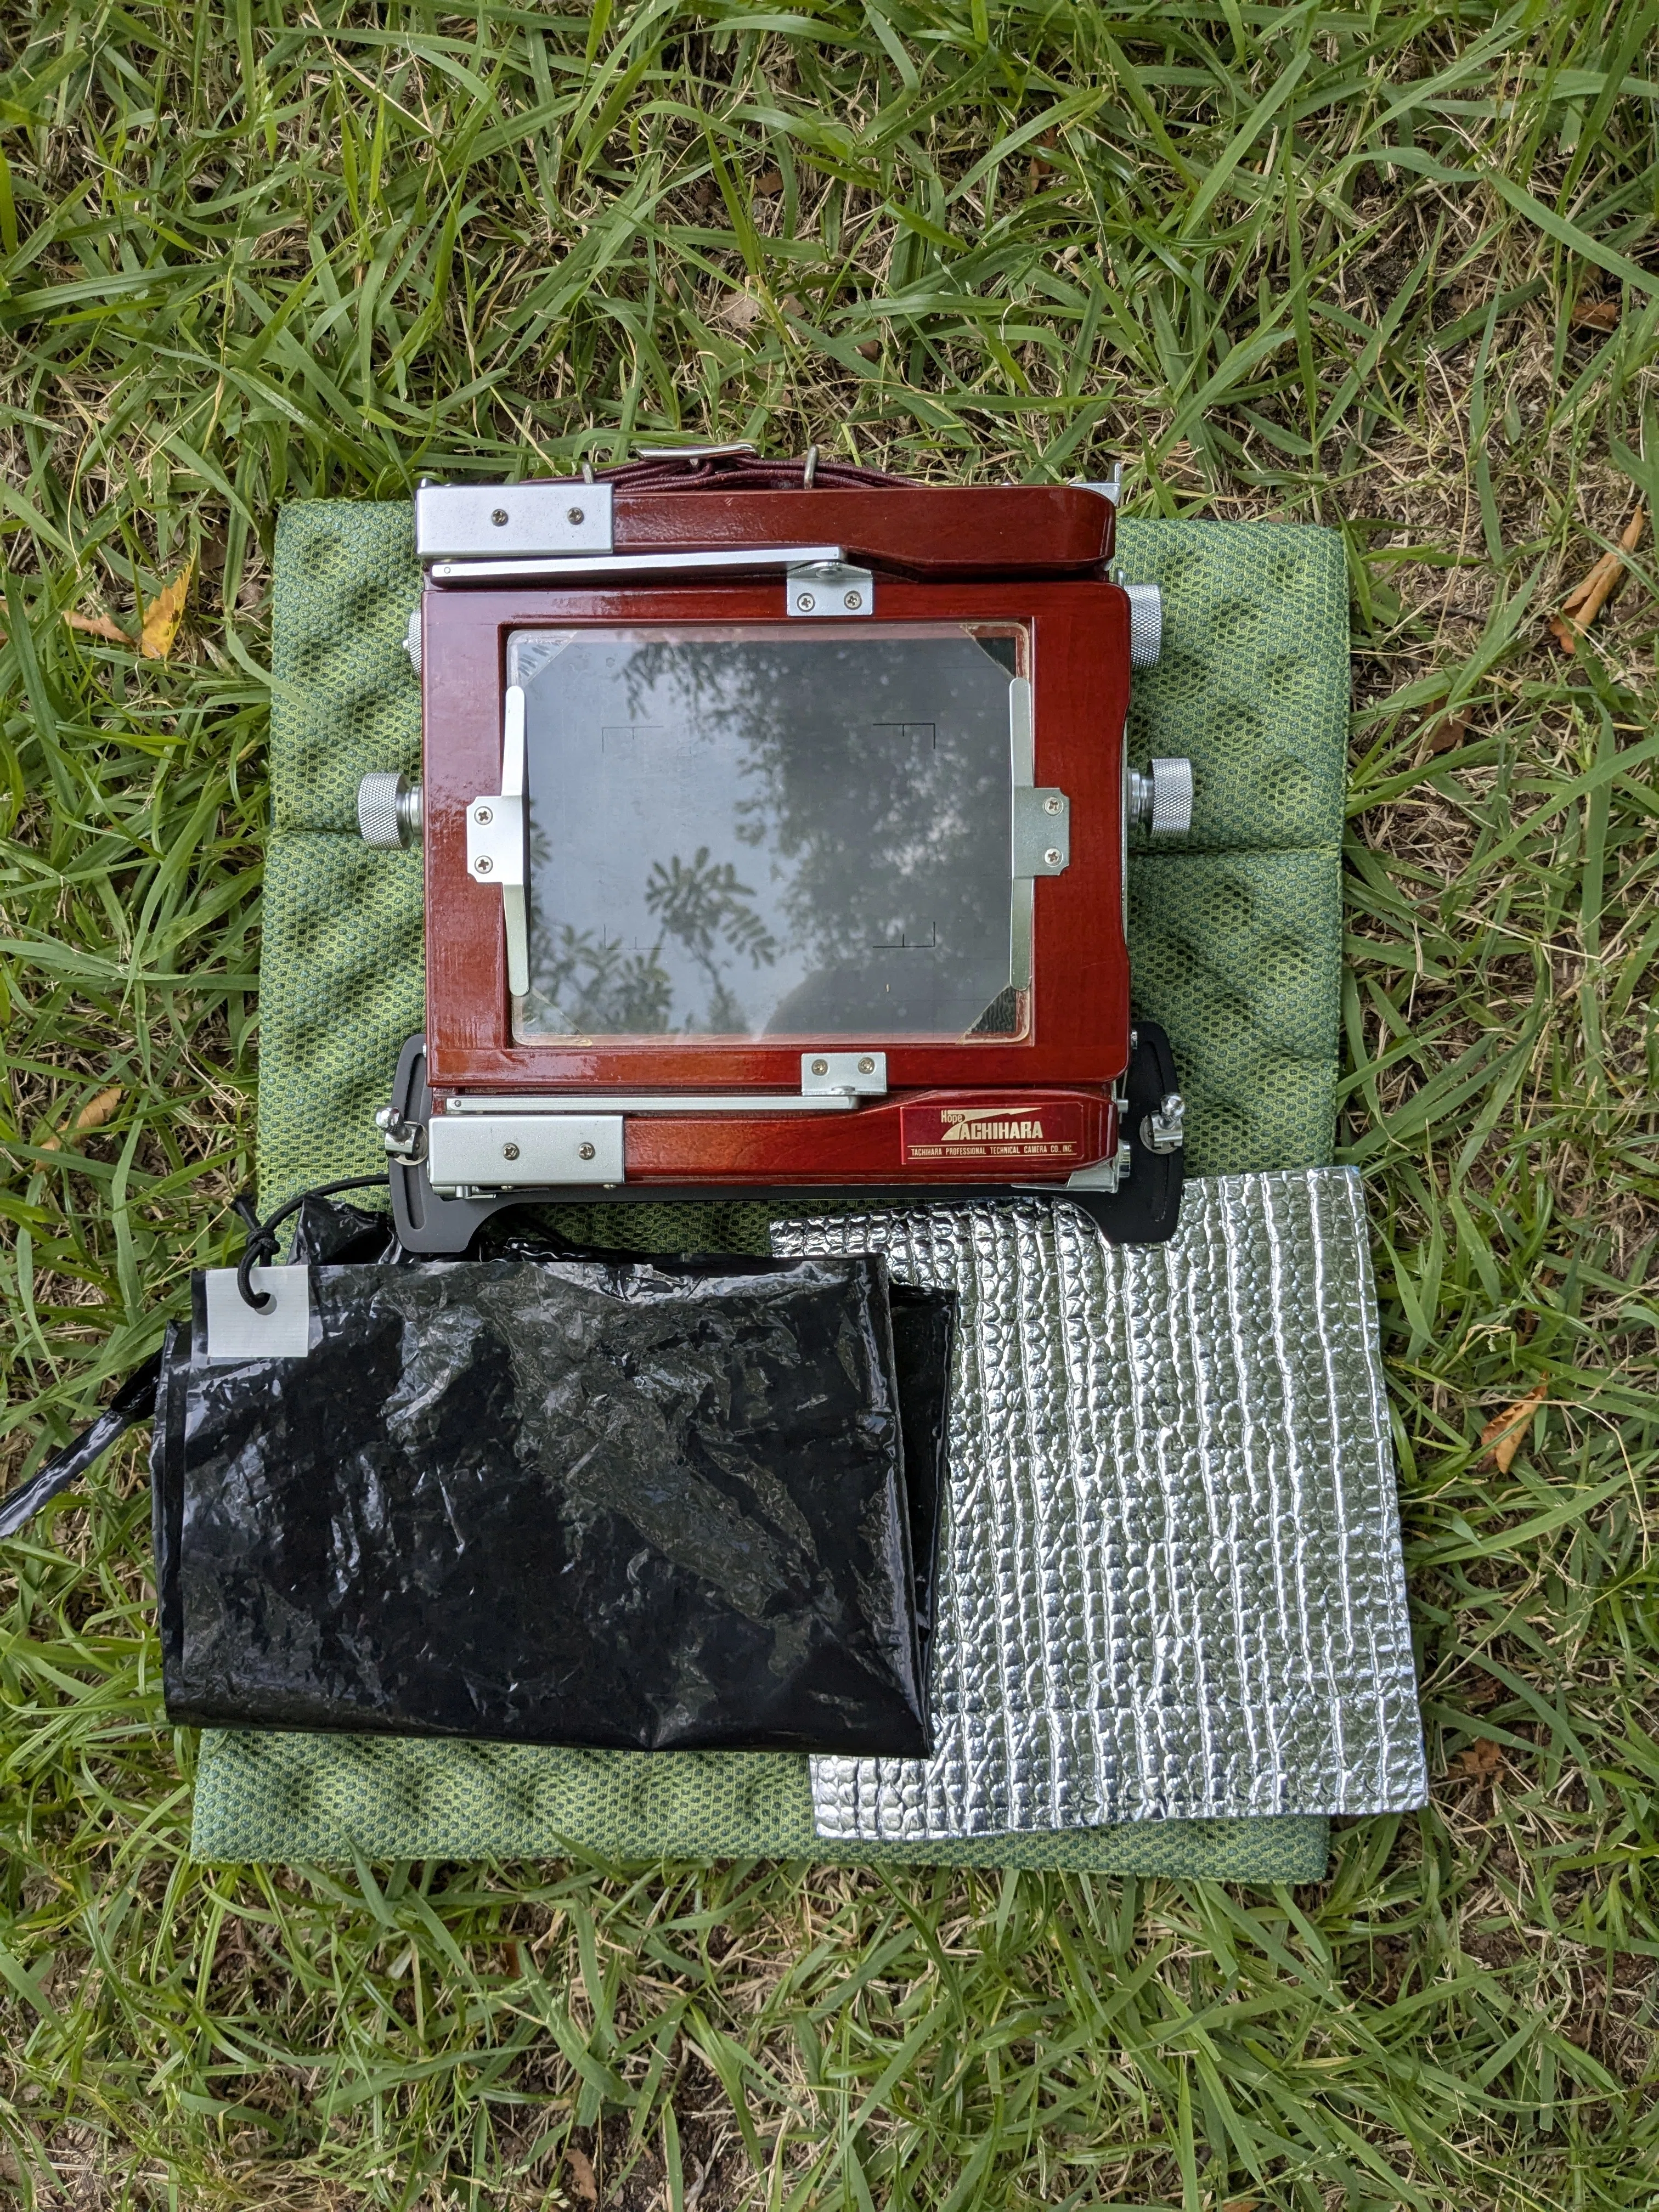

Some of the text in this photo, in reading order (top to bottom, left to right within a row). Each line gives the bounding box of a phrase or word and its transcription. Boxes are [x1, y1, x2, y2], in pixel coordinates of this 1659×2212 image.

[941, 1110, 962, 1125] Hope
[941, 1107, 1043, 1141] TACHIHARA
[911, 1148, 942, 1156] TACHIHARA
[945, 1147, 986, 1155] PROFESSIONAL
[990, 1146, 1020, 1154] TECHNICAL
[1024, 1146, 1047, 1154] CAMERA
[1062, 1144, 1073, 1153] INC.
